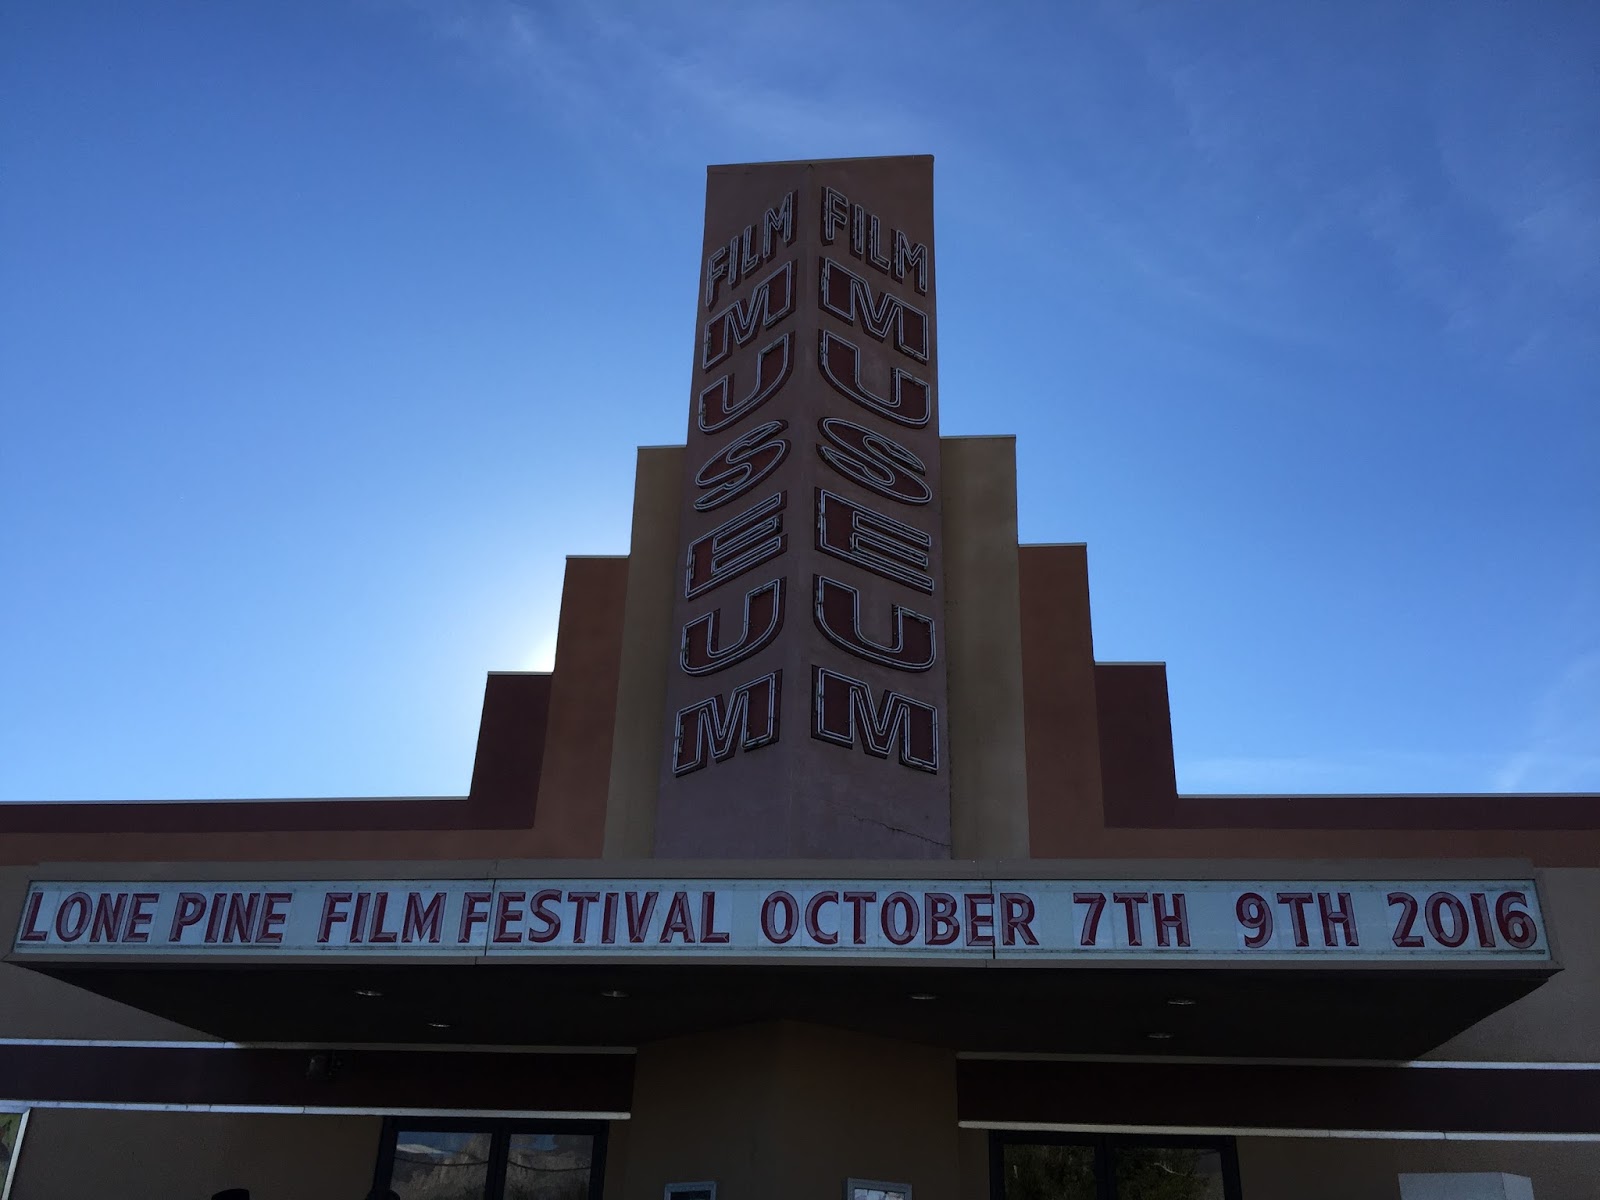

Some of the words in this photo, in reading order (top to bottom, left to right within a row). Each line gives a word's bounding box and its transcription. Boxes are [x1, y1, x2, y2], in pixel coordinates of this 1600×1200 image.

[705, 191, 798, 311] FILM
[821, 186, 928, 297] FILM
[673, 259, 797, 777] MUSEUM
[811, 255, 940, 776] MUSEUM
[20, 891, 159, 943] LONE
[169, 892, 292, 943] PINE
[317, 891, 447, 943] FILM
[459, 889, 730, 944] FESTIVAL
[760, 891, 1040, 946] OCTOBER
[1073, 892, 1191, 947] 7TH
[1235, 892, 1359, 949] 9TH
[1387, 891, 1538, 948] 2016
